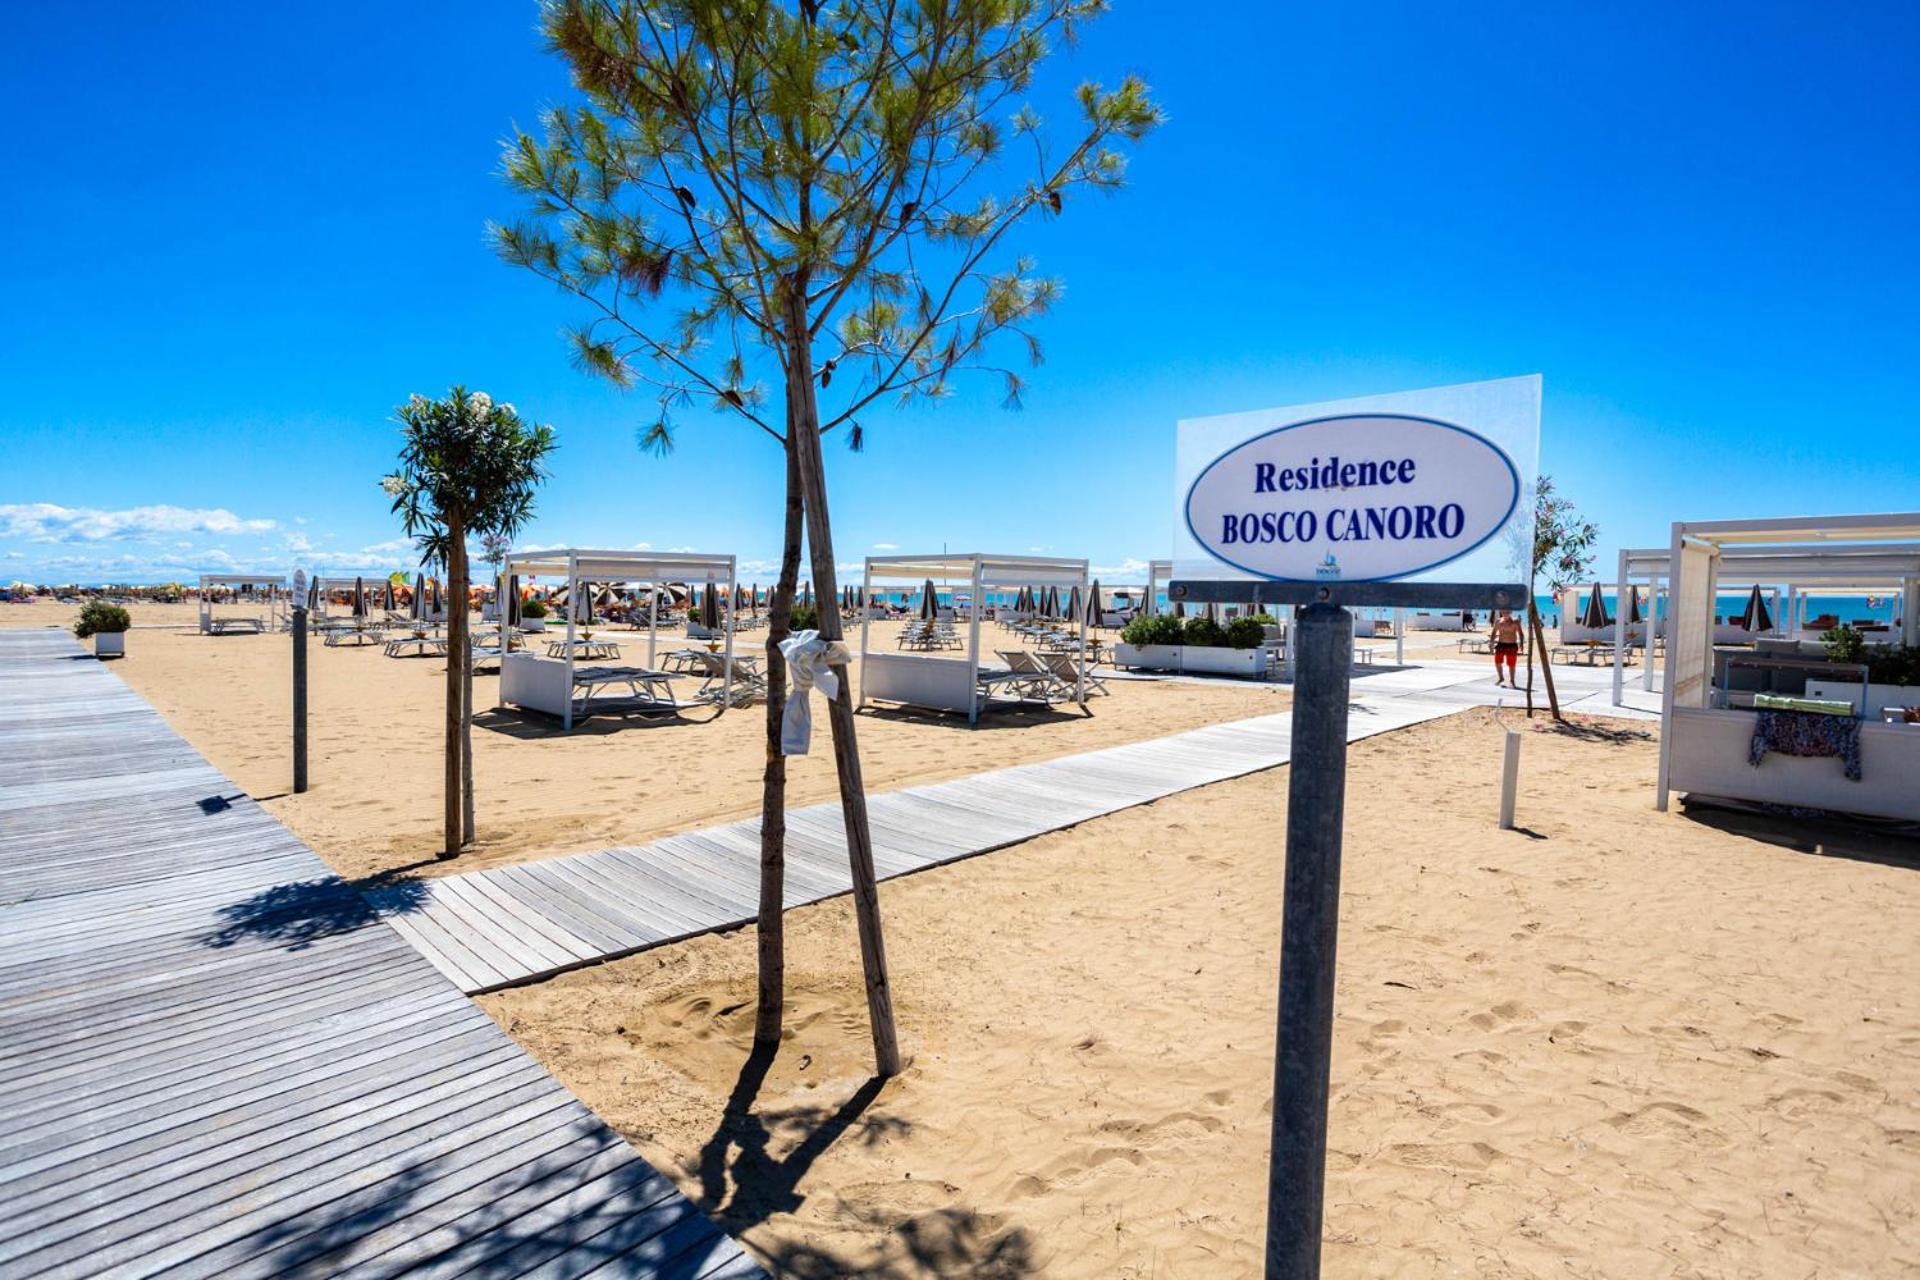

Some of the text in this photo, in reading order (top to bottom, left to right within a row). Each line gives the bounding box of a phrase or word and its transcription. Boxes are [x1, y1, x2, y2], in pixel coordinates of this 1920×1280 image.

[1254, 456, 1416, 494] Residence
[1221, 503, 1465, 545] BOSCO CANORO
